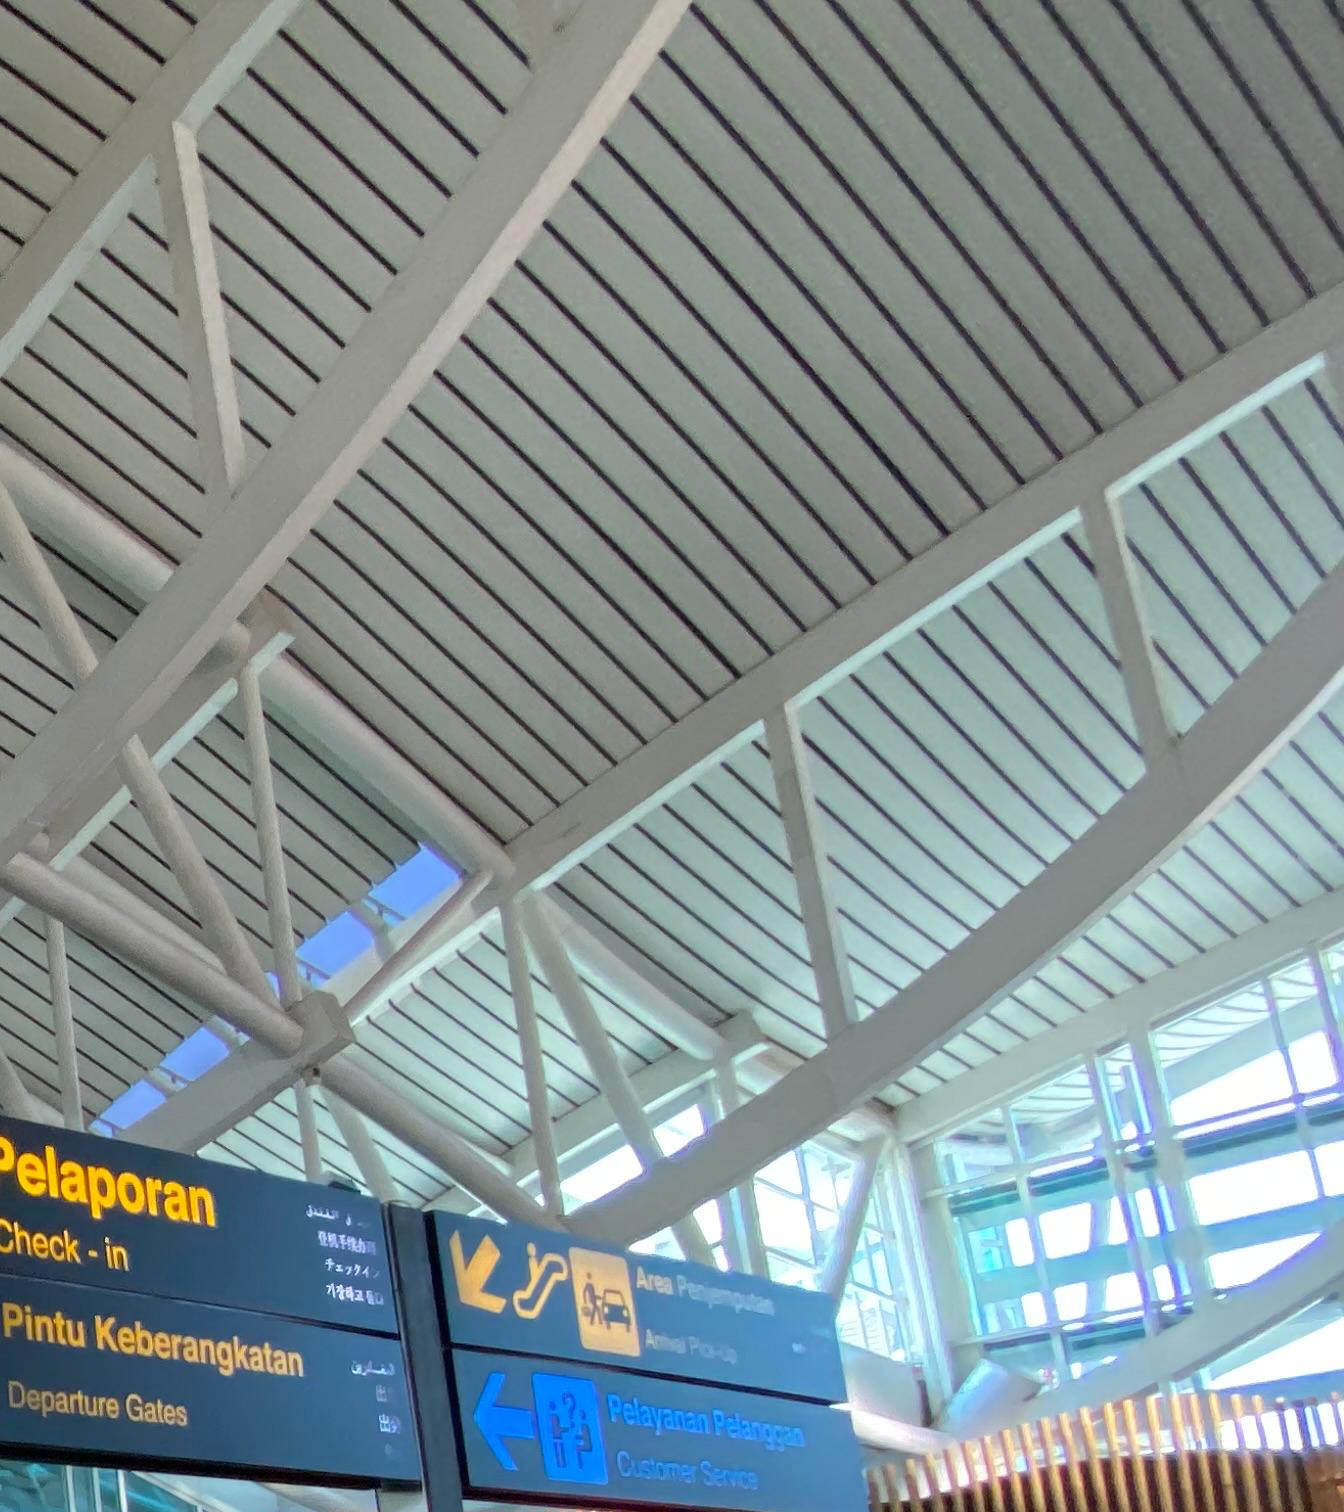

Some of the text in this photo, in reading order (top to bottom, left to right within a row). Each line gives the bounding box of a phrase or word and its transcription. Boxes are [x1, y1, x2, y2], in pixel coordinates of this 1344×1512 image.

[635, 1265, 673, 1295] Area
[2, 1302, 305, 1378] Pintu Keberangkatan
[7, 1381, 189, 1427] Departure Gates
[607, 1394, 710, 1436] Pelayanan
[617, 1451, 758, 1490] Customer Service
